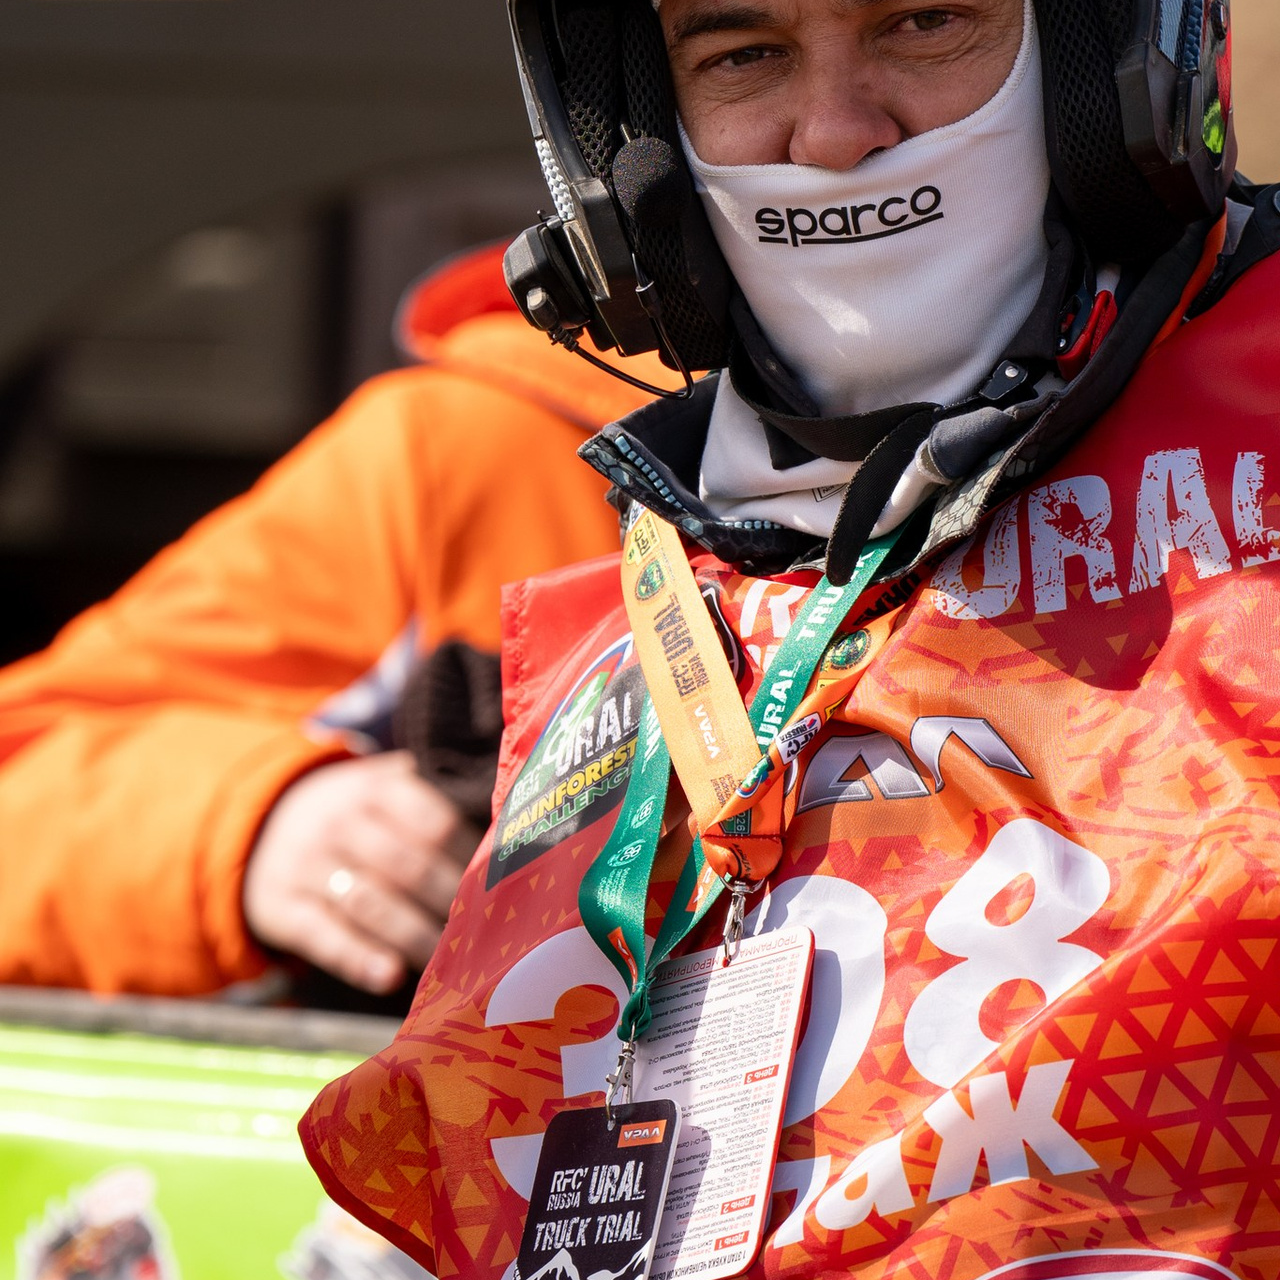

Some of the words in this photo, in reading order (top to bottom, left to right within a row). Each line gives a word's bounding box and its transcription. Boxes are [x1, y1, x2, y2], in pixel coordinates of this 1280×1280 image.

[755, 185, 943, 247] sparco
[652, 591, 695, 663] URAL
[757, 661, 801, 746] URAL
[502, 735, 637, 845] RAINFOREST
[753, 1067, 774, 1079] день
[588, 1160, 646, 1205] URAL
[547, 1191, 581, 1211] RUSSIA
[729, 1197, 751, 1211] день
[533, 1216, 592, 1252] TRUCK
[594, 1210, 643, 1245] TRIAL
[723, 1233, 744, 1246] день
[706, 1255, 727, 1268] КУБКА
[726, 1251, 742, 1262] ЭТАП
